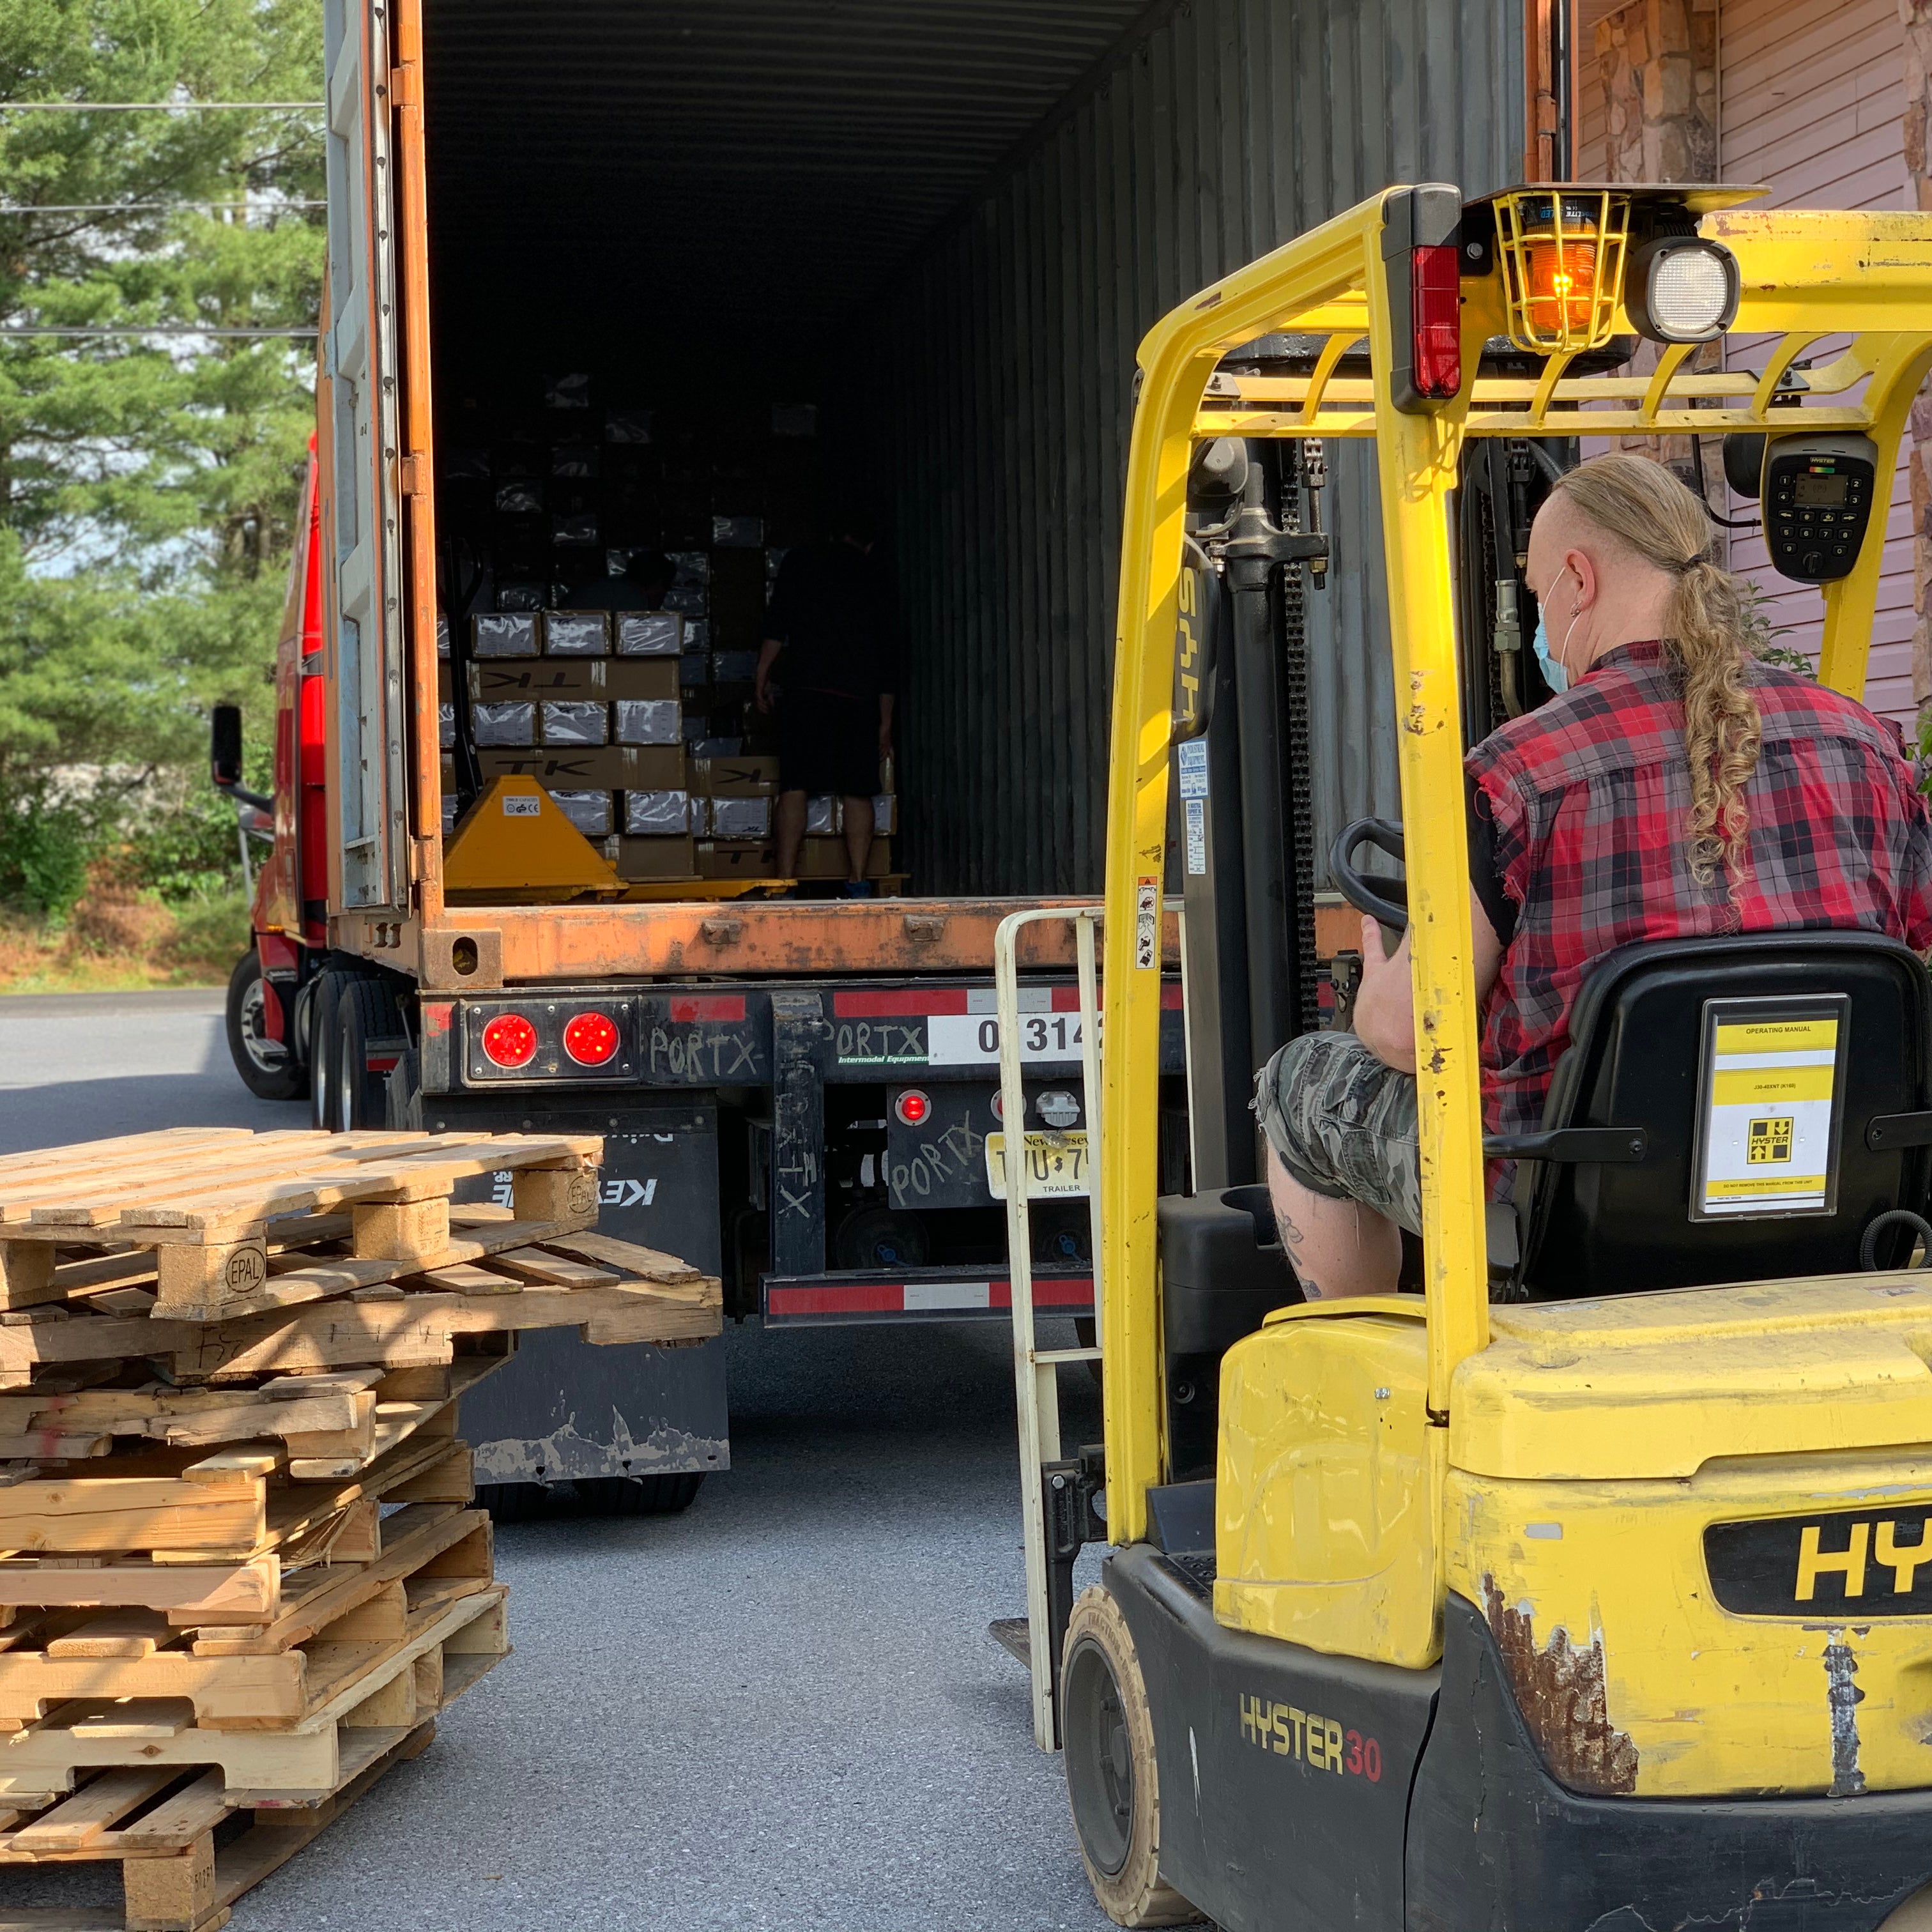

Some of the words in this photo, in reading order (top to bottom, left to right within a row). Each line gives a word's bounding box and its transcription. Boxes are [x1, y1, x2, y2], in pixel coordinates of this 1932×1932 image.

[480, 672, 581, 688] TK
[495, 760, 597, 776] TK
[651, 1026, 759, 1081] PORTX
[1751, 1136, 1788, 1144] HYSTER
[892, 1110, 983, 1206] PORTX
[997, 1149, 1049, 1181] TU
[231, 1257, 260, 1284] EPAL
[1239, 1692, 1343, 1775] HYSTER
[1346, 1728, 1383, 1783] 30
